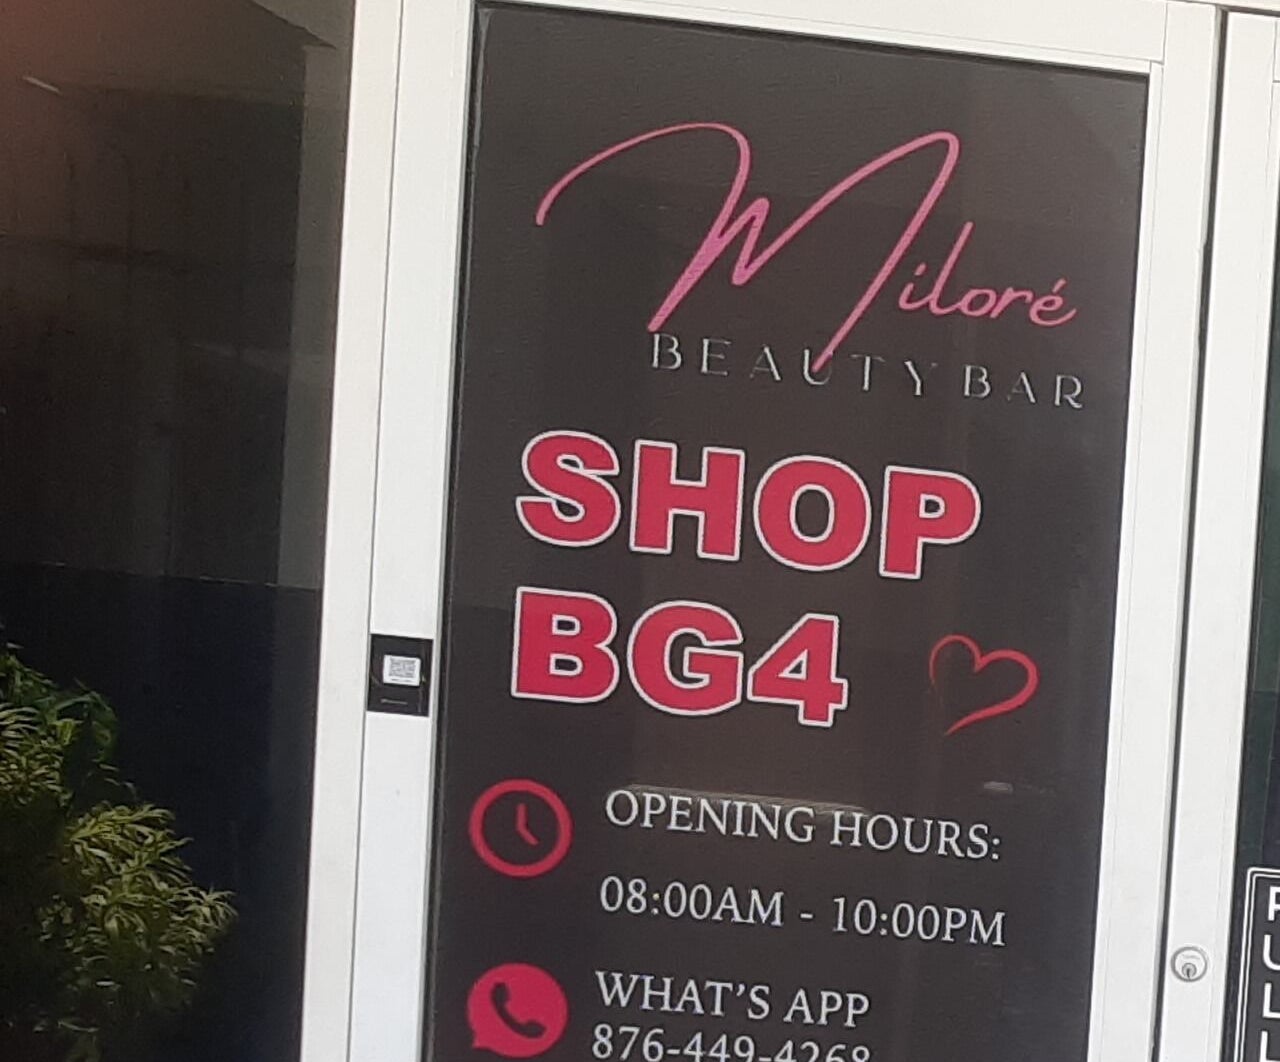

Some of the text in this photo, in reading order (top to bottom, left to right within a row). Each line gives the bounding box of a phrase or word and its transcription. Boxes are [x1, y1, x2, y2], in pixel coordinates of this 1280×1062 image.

[536, 122, 1077, 372] Miloré
[651, 332, 1085, 409] BEAUTY BAR
[516, 430, 982, 579] SHOP
[511, 586, 848, 727] BG4
[604, 789, 1001, 860] OPENING HOURS:
[599, 876, 785, 928] 08:00AM
[832, 897, 1006, 946] 10:00PM
[784, 988, 870, 1029] APP
